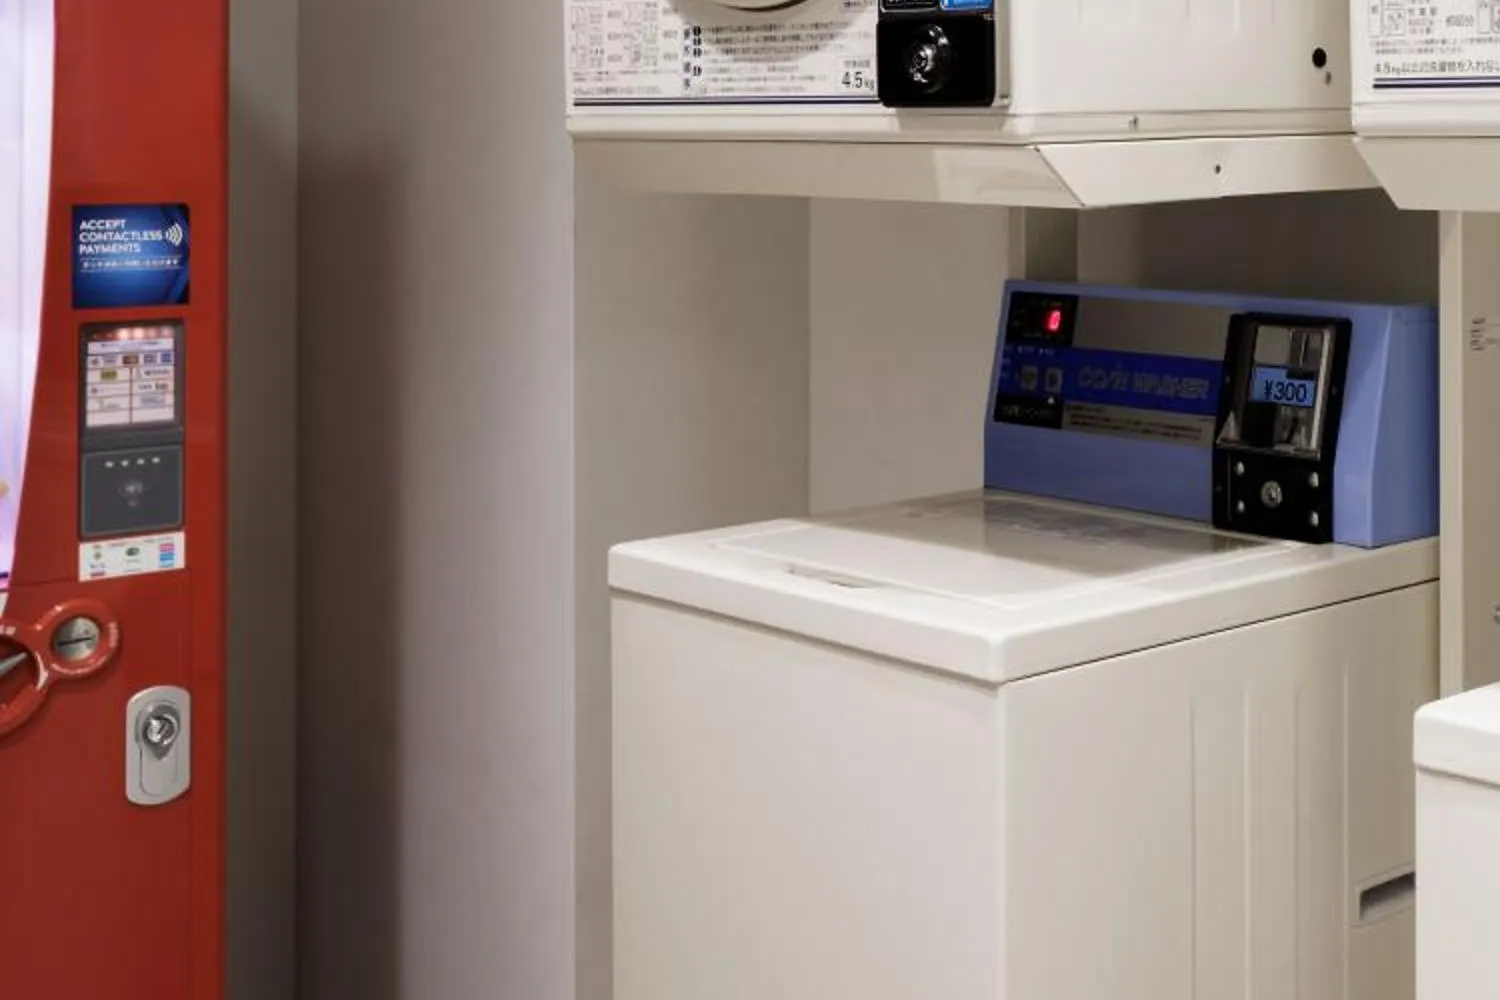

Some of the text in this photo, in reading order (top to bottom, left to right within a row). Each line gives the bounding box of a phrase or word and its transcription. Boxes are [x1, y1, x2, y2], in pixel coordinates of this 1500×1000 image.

[80, 220, 126, 230] ACCEPT
[80, 231, 162, 242] CONTACTLESS
[80, 244, 141, 254] PAYMENTS
[1264, 379, 1308, 403] ¥300
